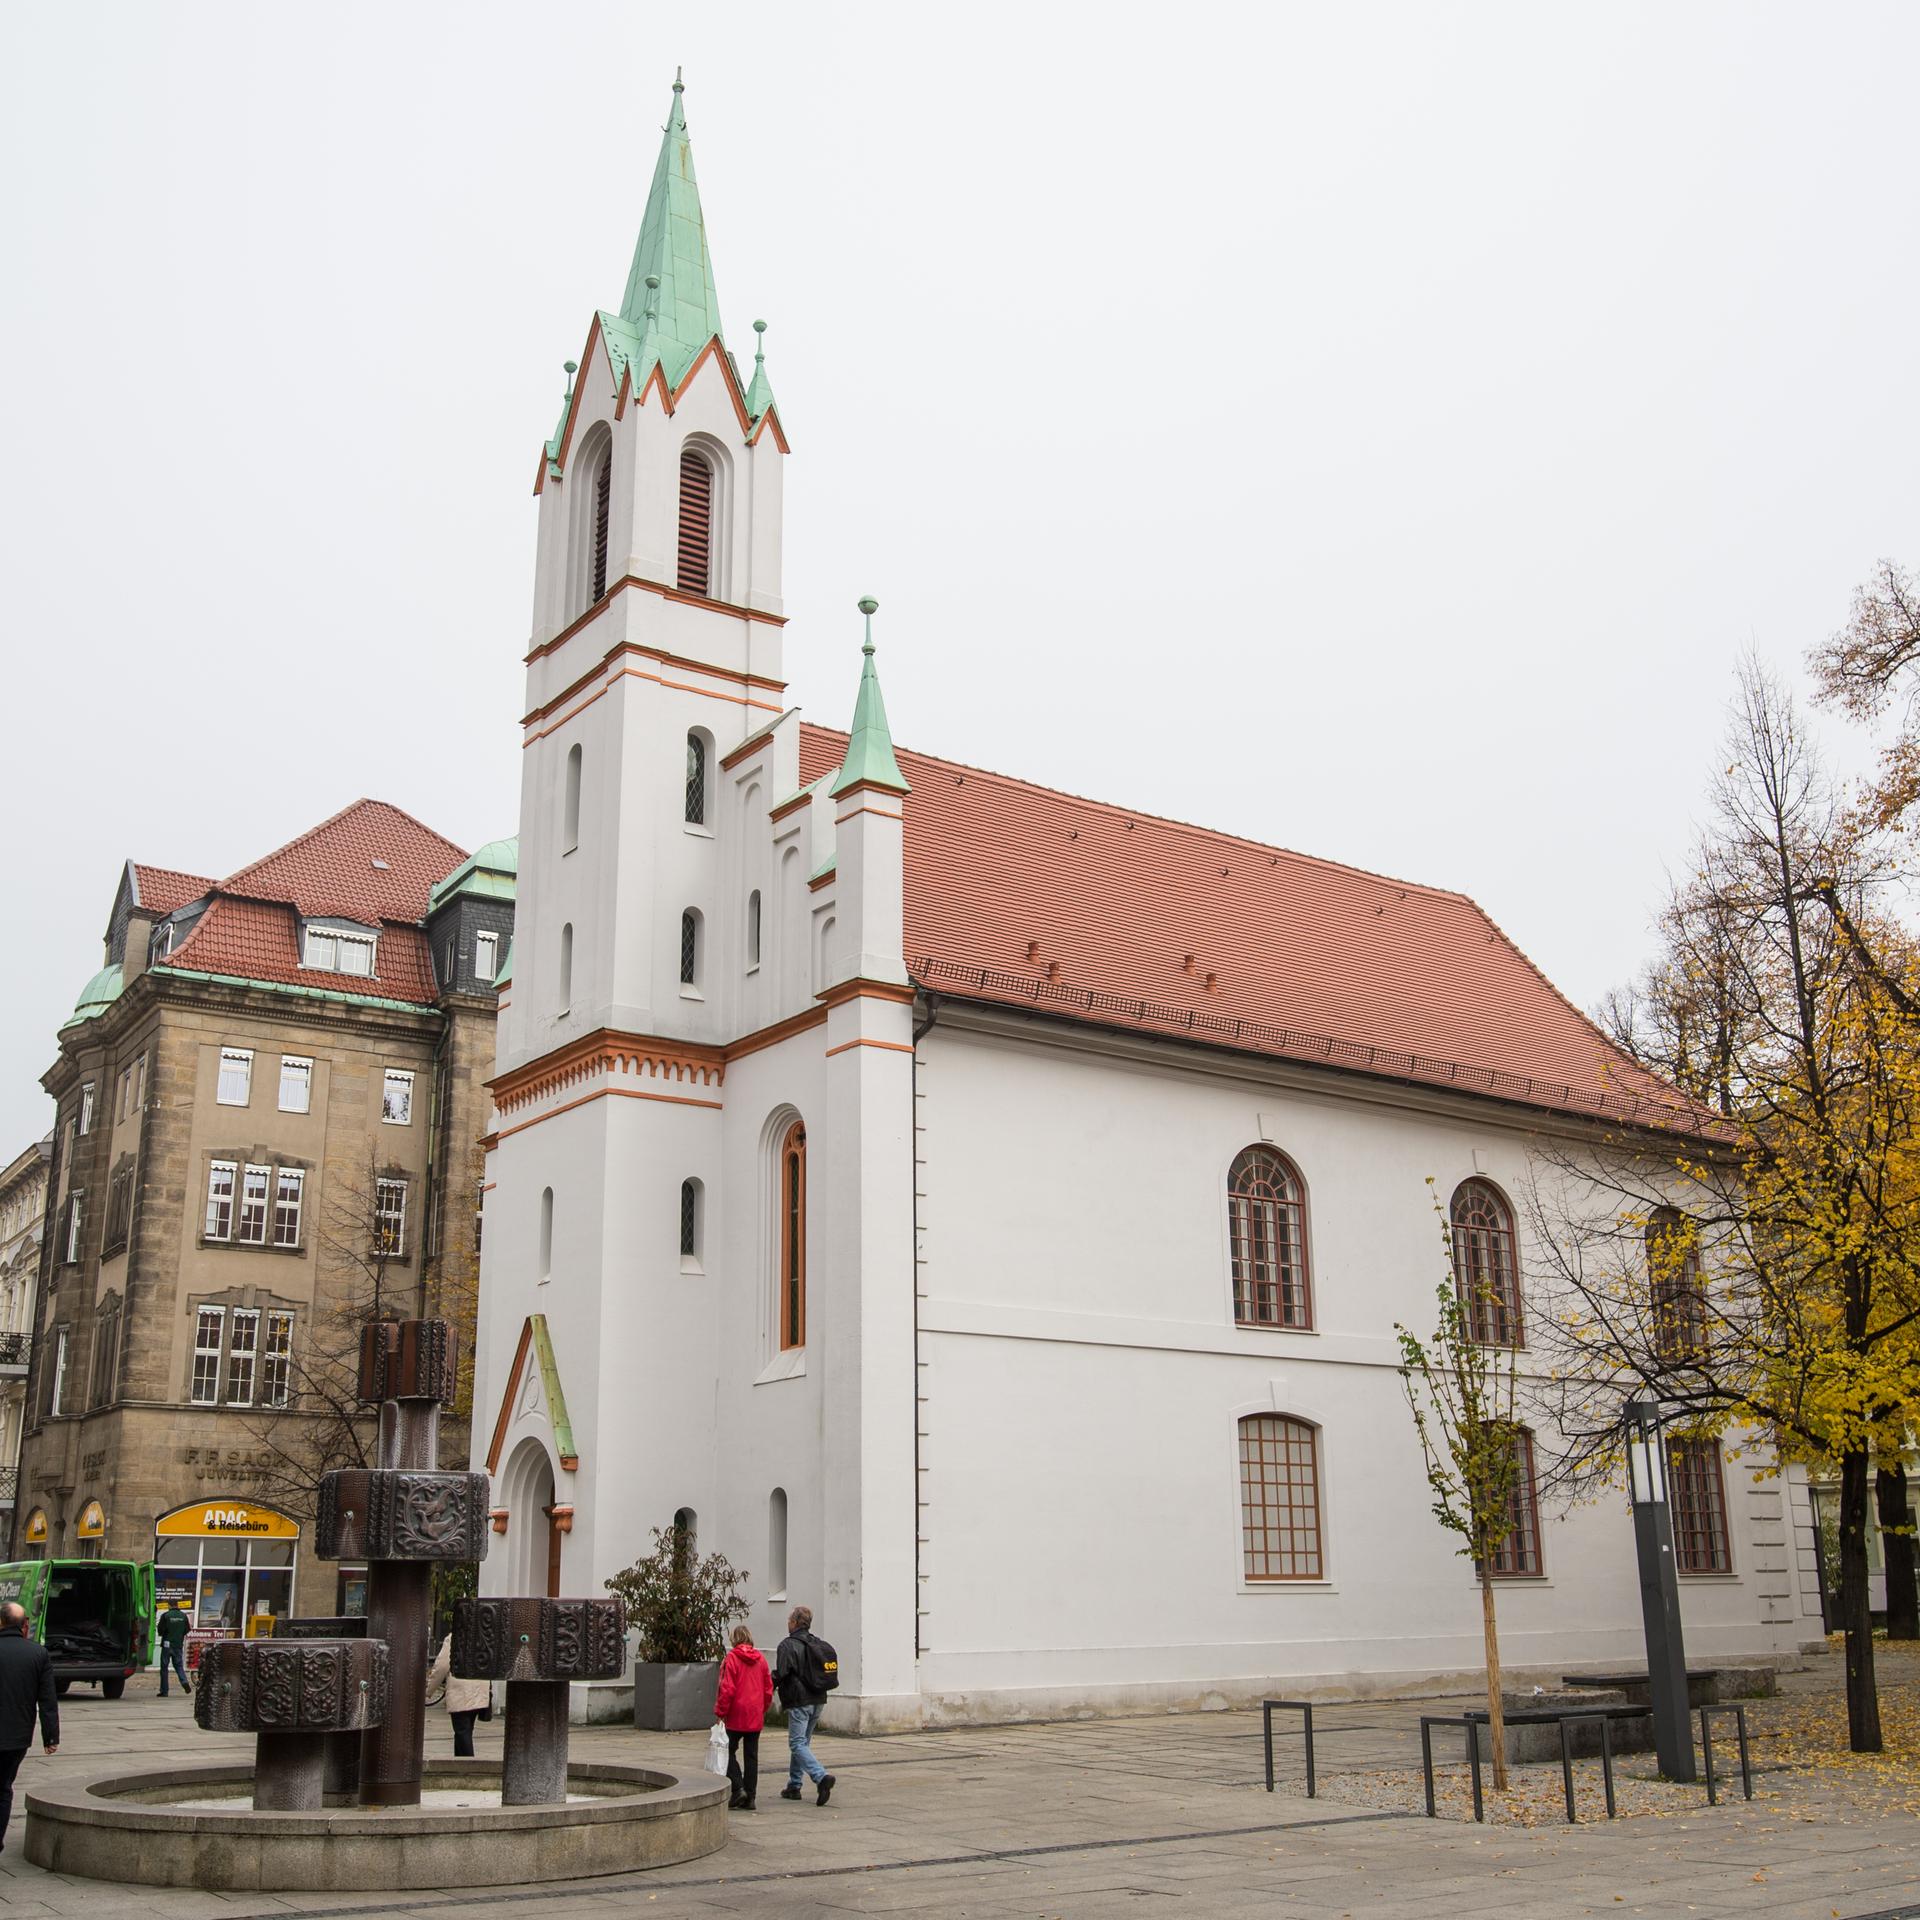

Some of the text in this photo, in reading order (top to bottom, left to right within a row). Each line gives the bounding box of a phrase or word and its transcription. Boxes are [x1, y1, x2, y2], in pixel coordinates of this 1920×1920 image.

[203, 1509, 247, 1525] ADAC
[207, 1519, 269, 1531] & Reisebüro
[212, 1630, 224, 1638] Tee
